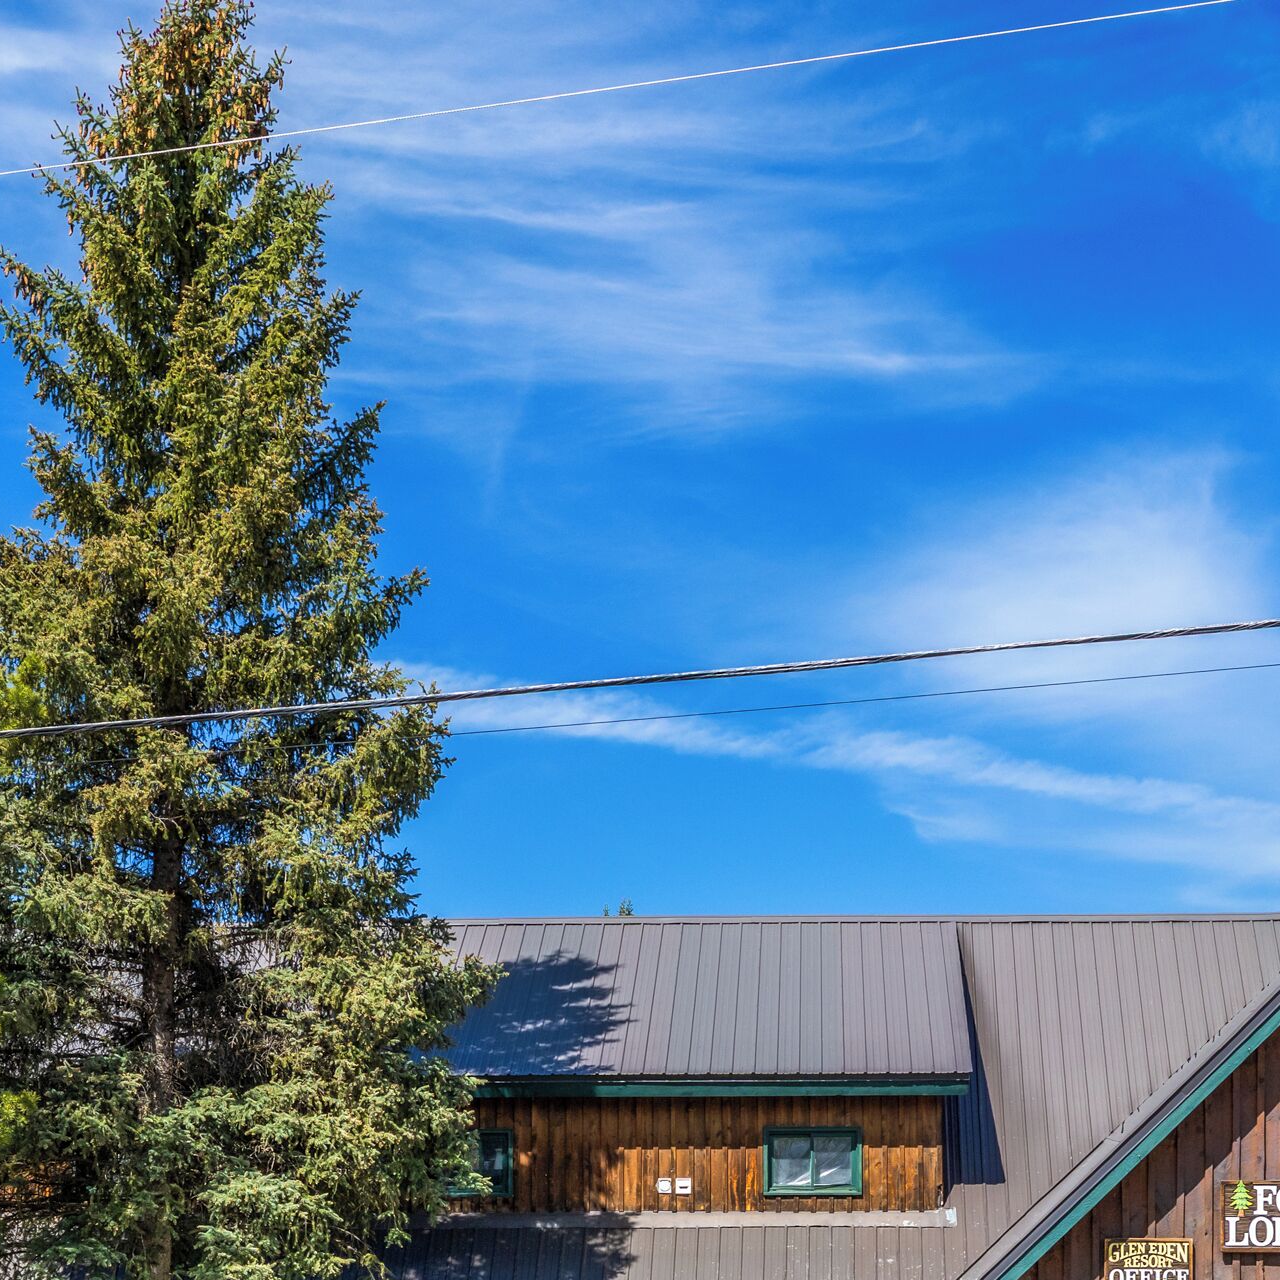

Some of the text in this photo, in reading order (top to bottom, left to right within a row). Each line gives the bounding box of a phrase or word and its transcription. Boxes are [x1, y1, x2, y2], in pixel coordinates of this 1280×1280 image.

[1108, 1242, 1189, 1263] GLEN EDEN
[1123, 1254, 1174, 1268] RESORT
